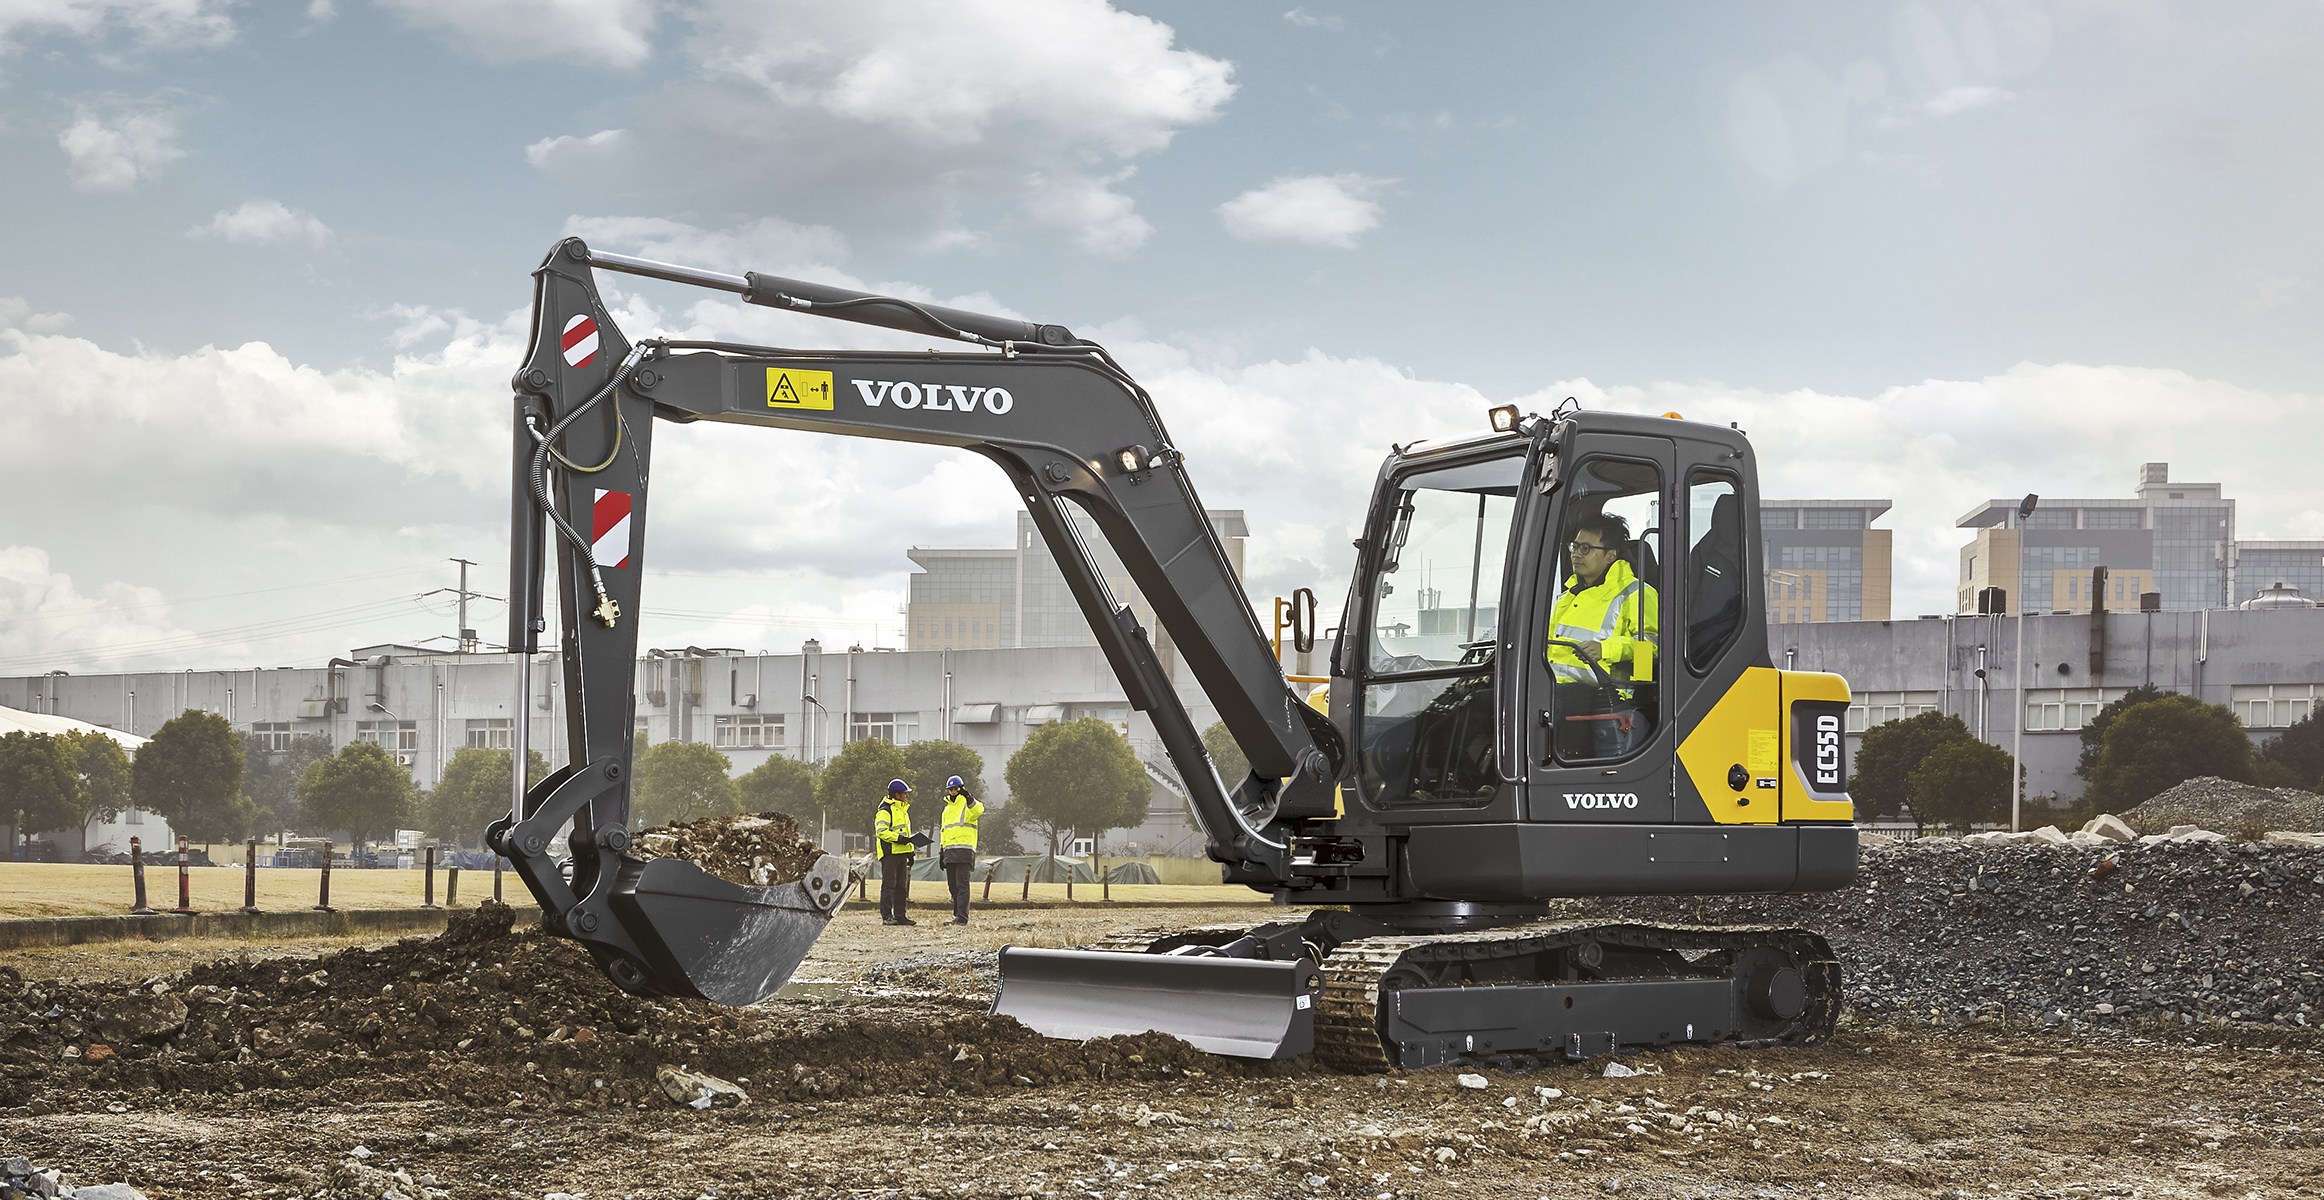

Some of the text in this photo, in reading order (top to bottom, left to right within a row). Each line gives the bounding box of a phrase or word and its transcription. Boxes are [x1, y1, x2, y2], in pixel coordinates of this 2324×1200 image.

[850, 379, 1014, 415] VOLVO
[1816, 715, 1839, 784] EC55D
[1562, 792, 1639, 809] VOLVO
